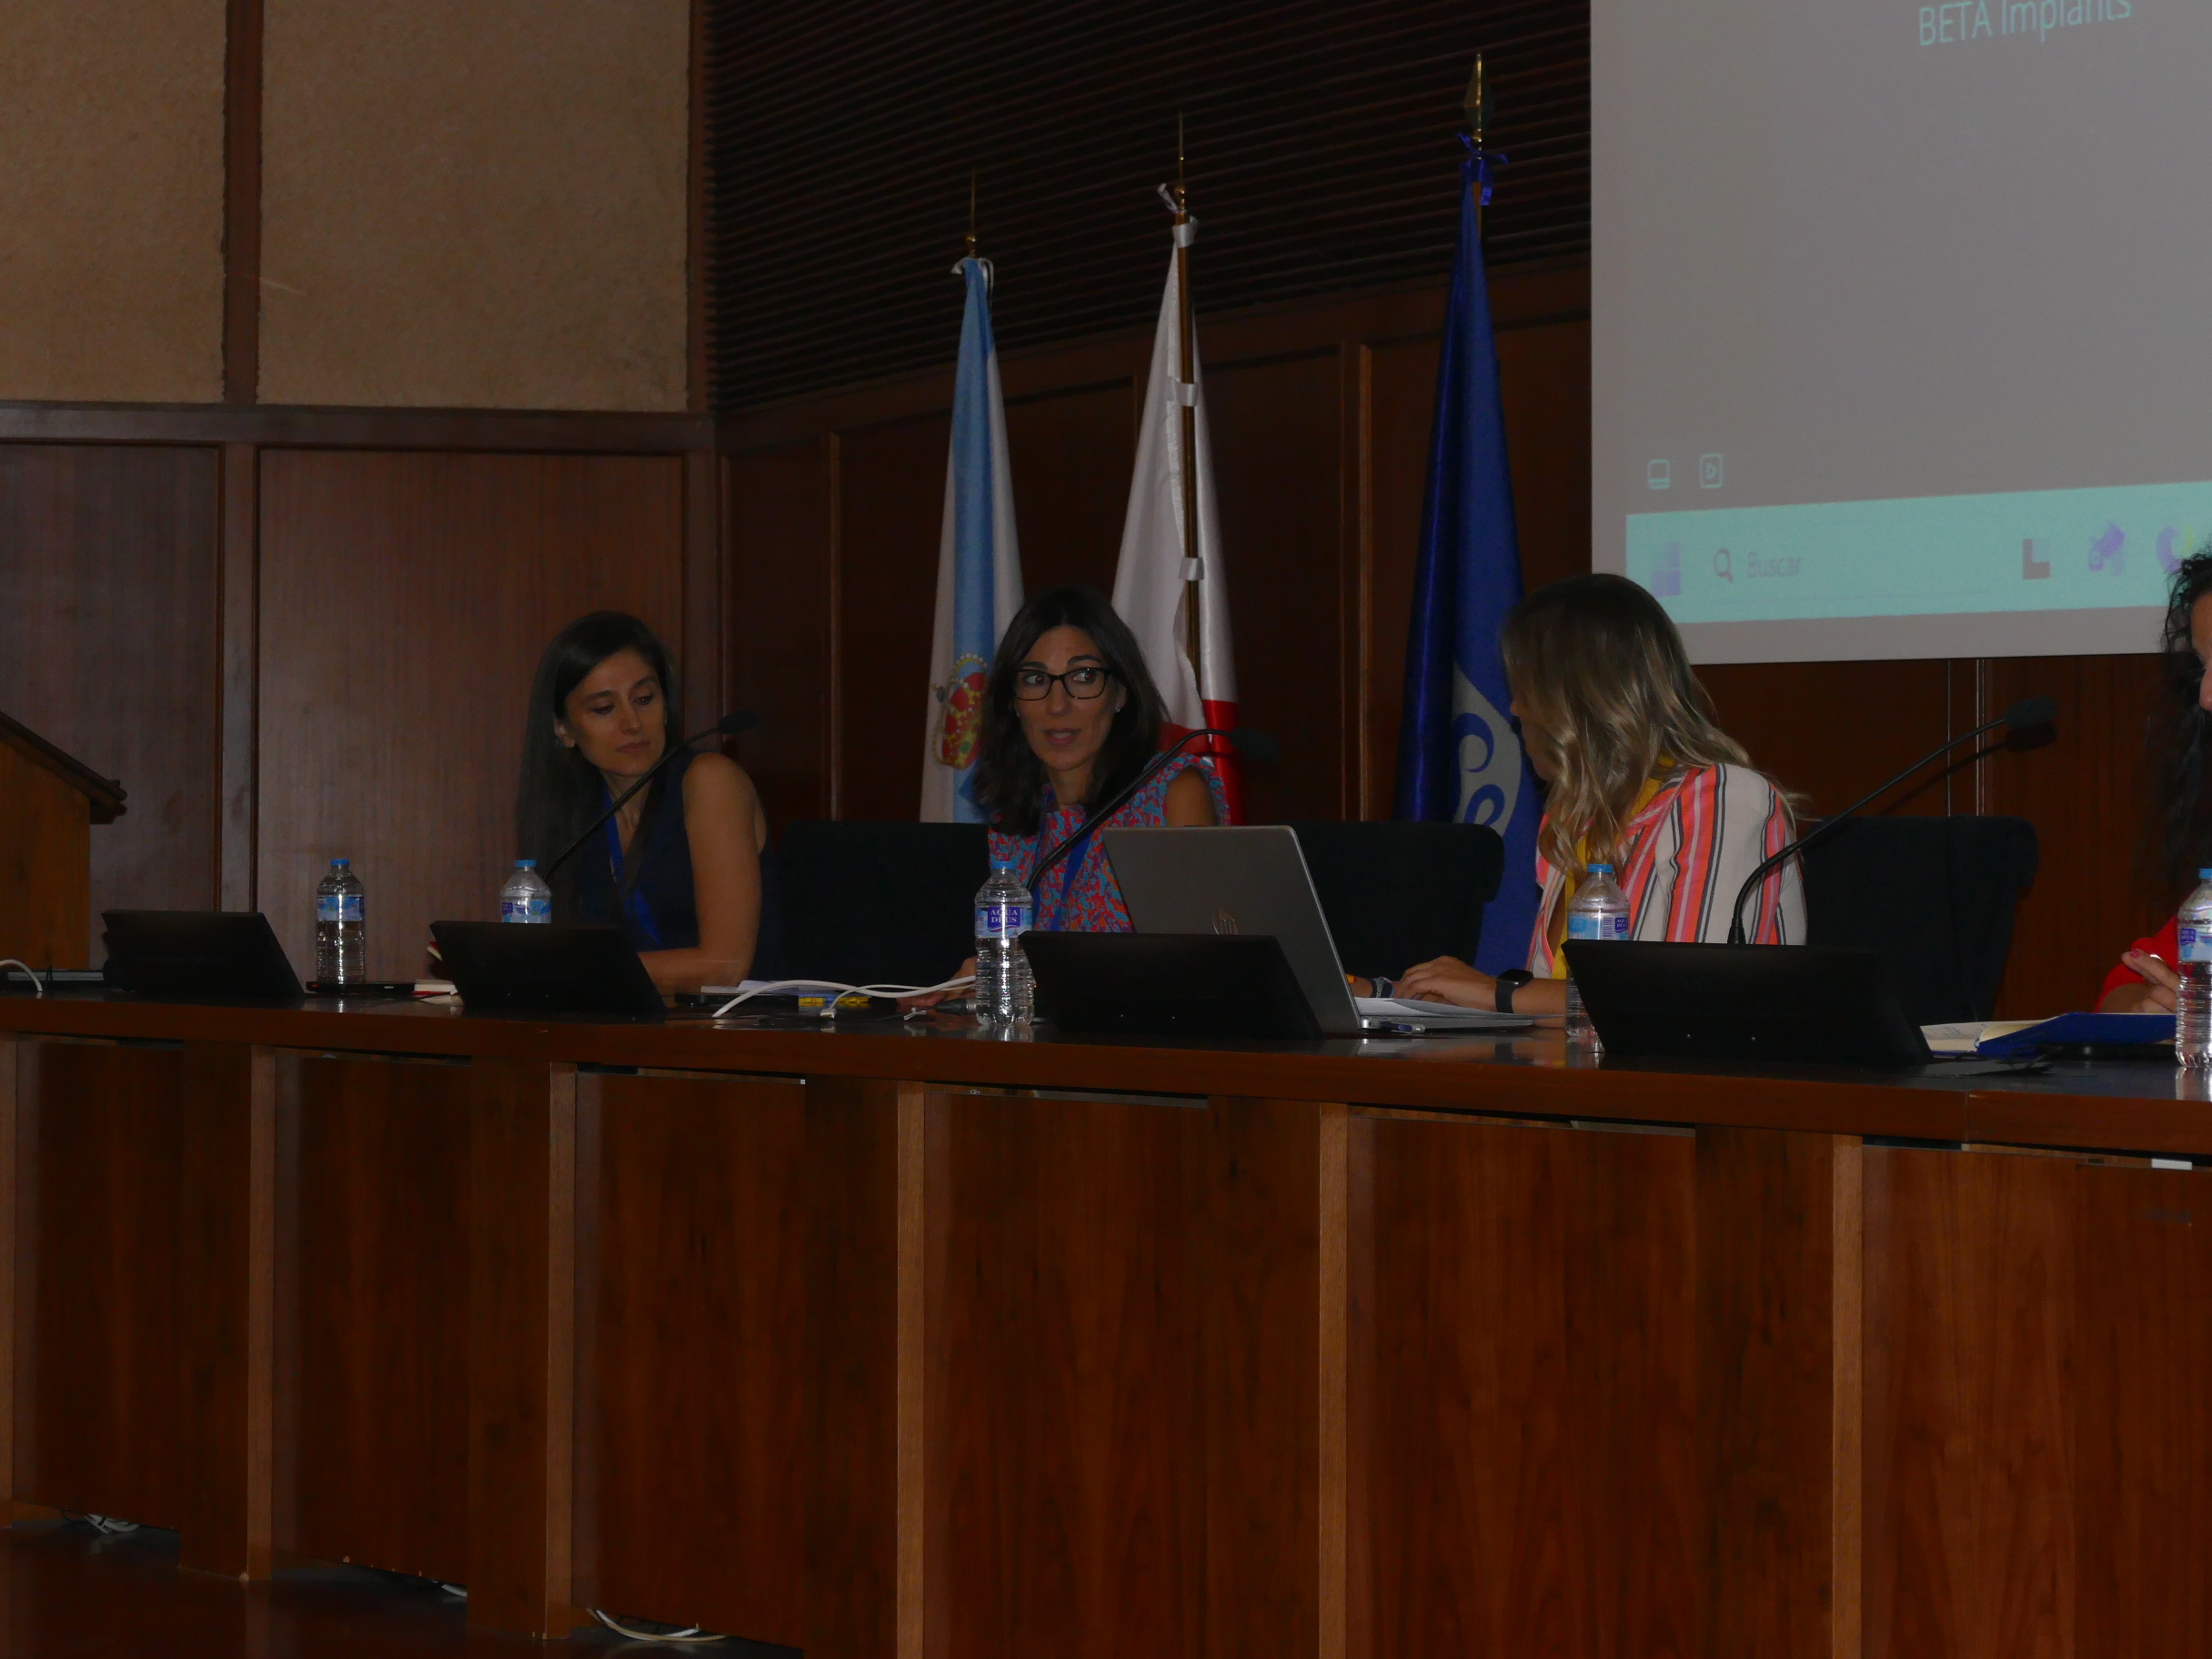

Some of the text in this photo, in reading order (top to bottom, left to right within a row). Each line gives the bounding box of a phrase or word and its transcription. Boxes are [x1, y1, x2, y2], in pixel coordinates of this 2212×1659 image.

[1919, 0, 2132, 46] BETA Implants
[1747, 551, 1803, 578] Buscar
